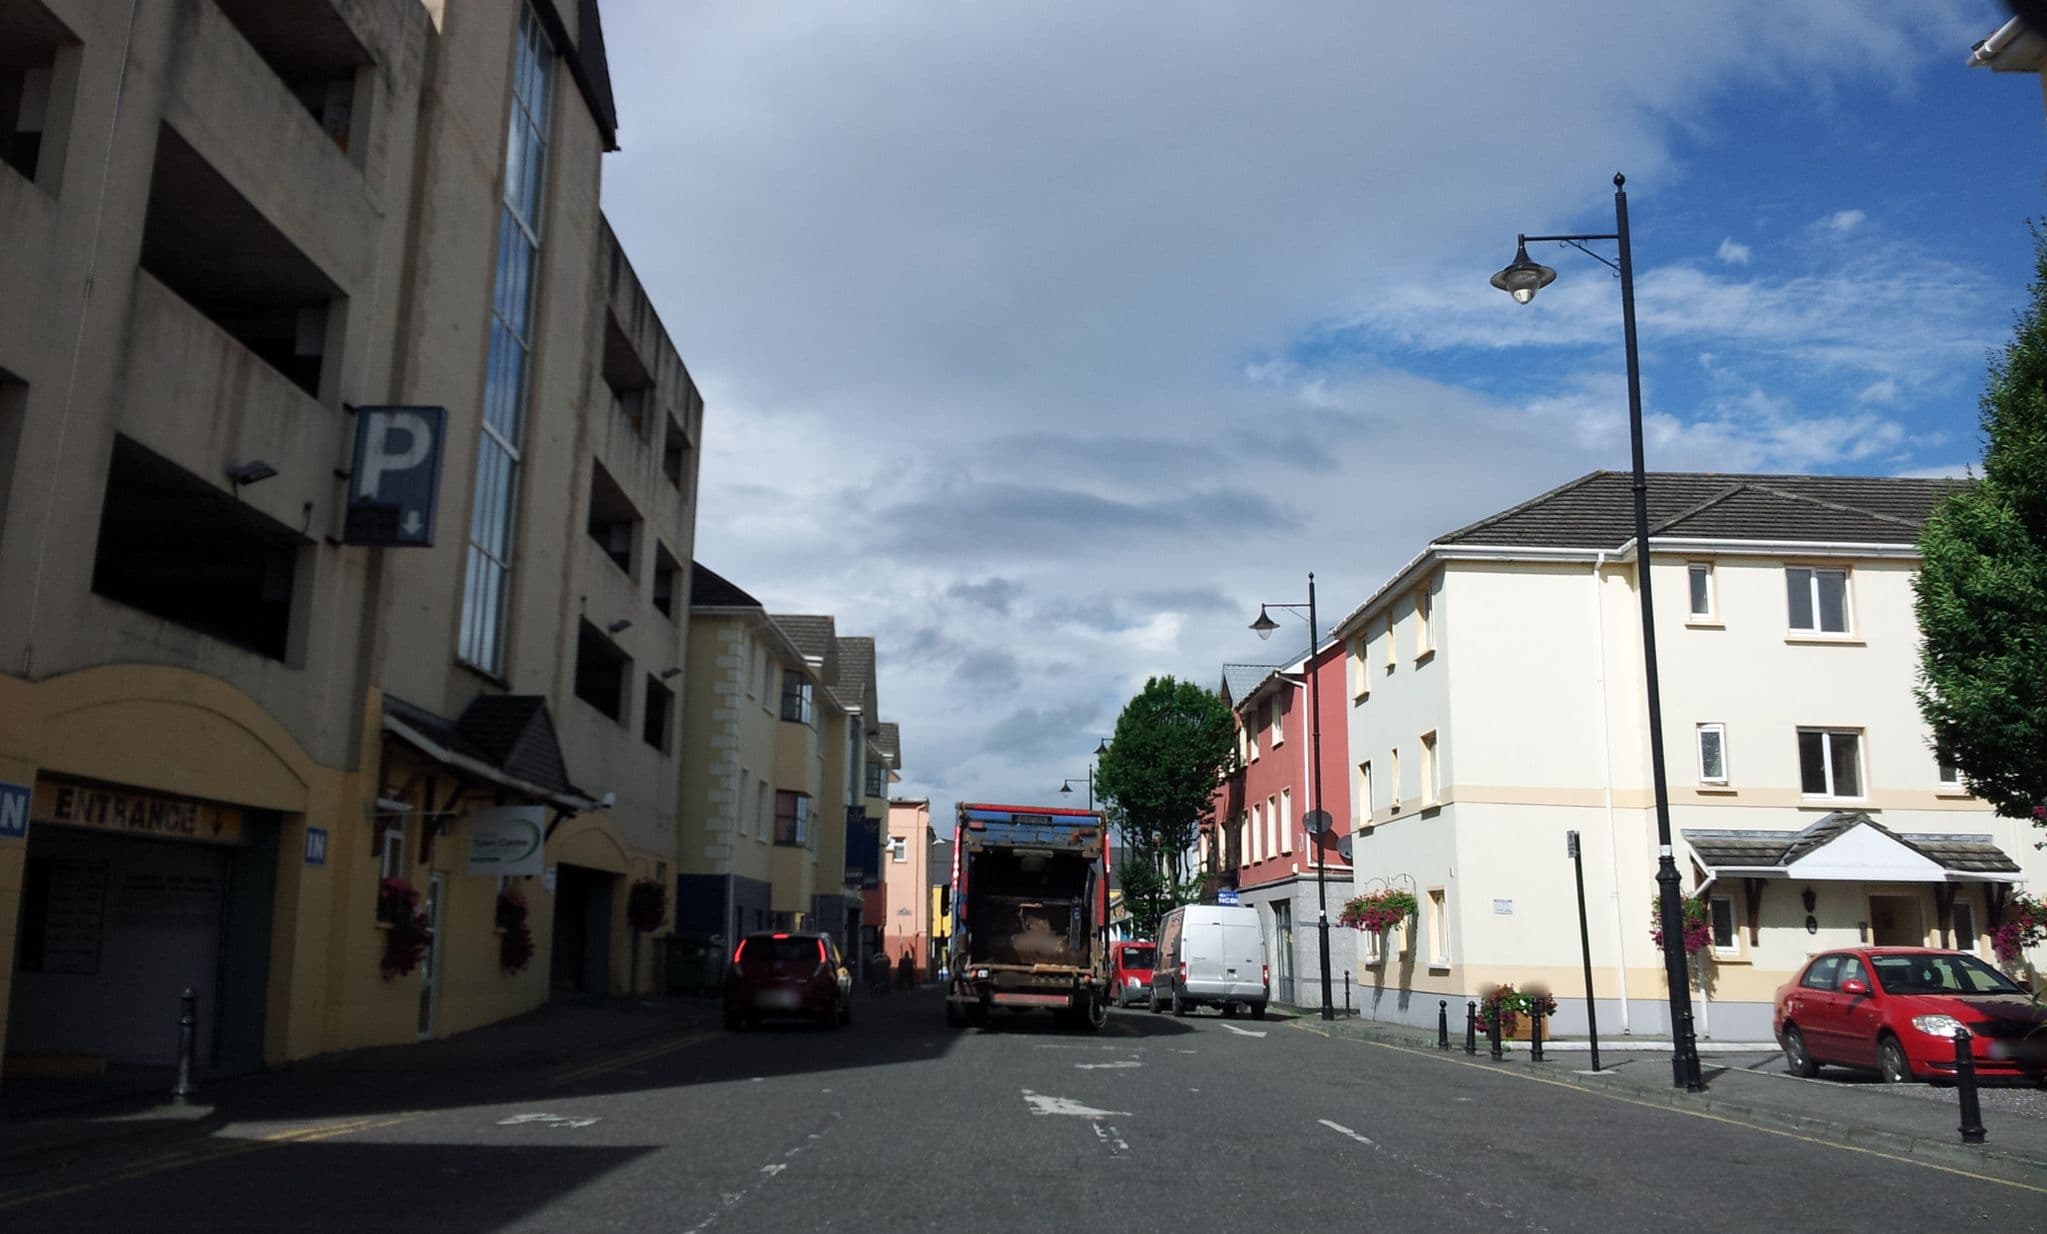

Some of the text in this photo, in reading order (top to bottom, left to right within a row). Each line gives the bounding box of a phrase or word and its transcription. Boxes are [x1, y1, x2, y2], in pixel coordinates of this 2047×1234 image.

[360, 412, 432, 501] P
[0, 790, 27, 831] N
[54, 787, 197, 835] ENTRANCE
[307, 831, 325, 860] IN
